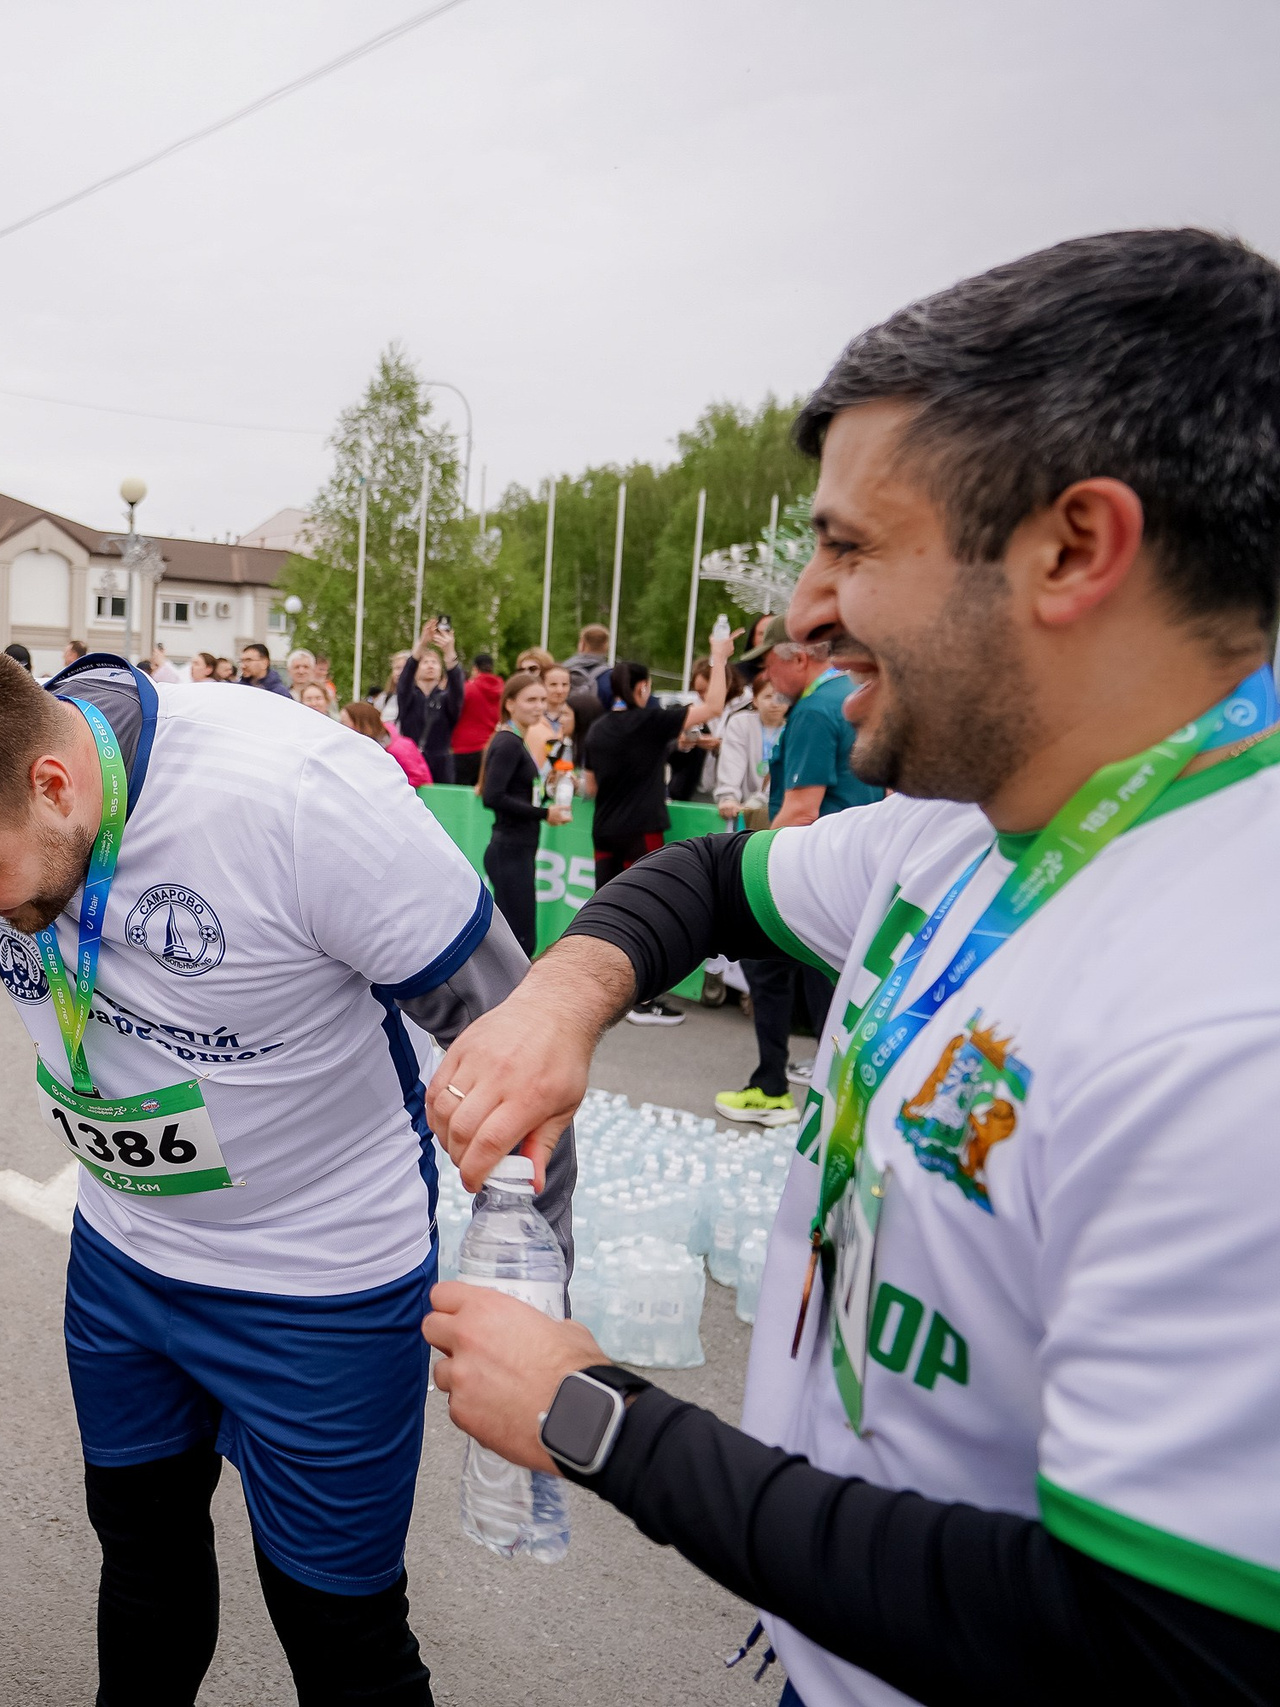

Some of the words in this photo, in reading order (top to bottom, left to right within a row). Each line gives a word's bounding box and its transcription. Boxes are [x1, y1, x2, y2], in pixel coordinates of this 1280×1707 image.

[92, 716, 109, 744] СБЕР
[111, 773, 119, 795] лет
[110, 798, 119, 817] 185
[87, 894, 99, 917] Utair
[139, 889, 205, 915] САМАРОВО
[46, 946, 59, 975] СБЕР
[82, 951, 91, 979] СБЕР
[3, 977, 40, 998] САРЕЙ
[57, 986, 66, 1005] 185
[874, 974, 904, 1019] СБЕР
[61, 1006, 70, 1026] лет
[871, 1026, 909, 1068] СБЕР
[51, 1107, 197, 1168] 1386
